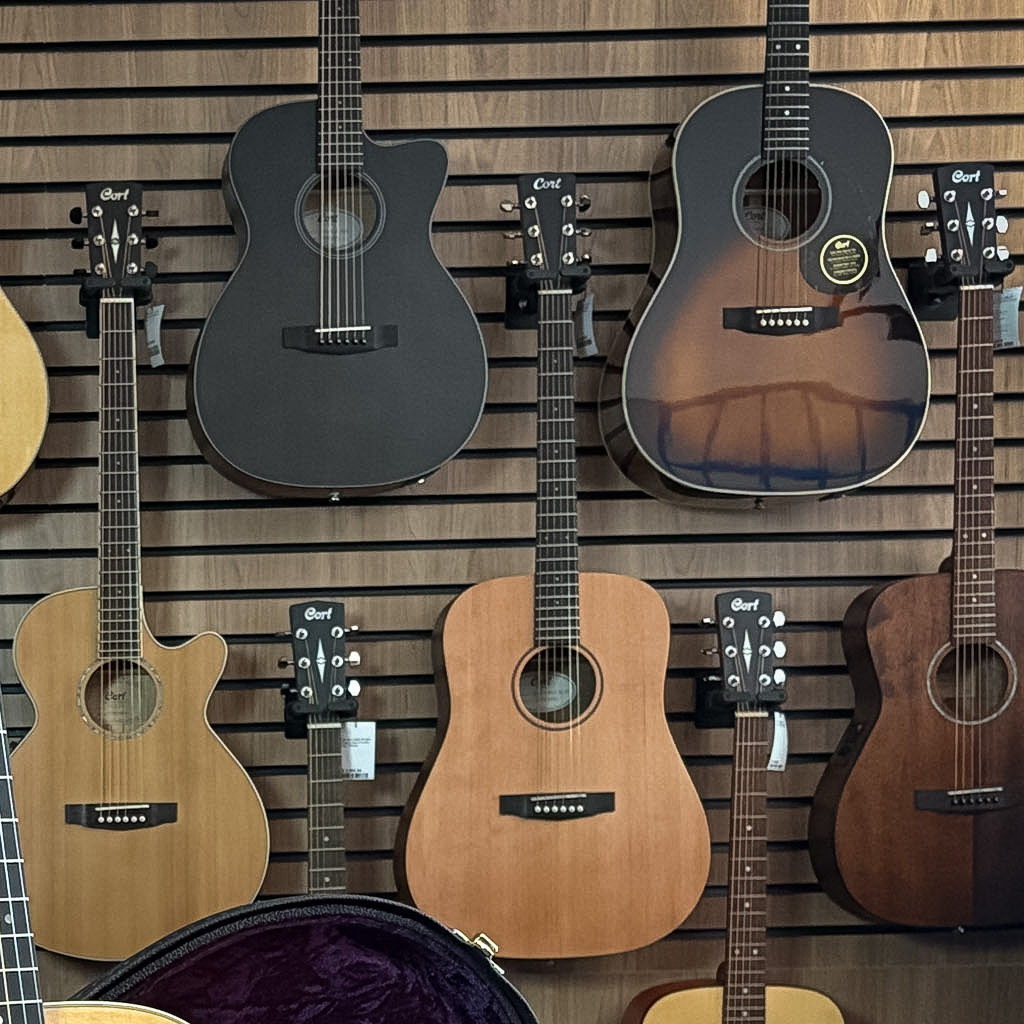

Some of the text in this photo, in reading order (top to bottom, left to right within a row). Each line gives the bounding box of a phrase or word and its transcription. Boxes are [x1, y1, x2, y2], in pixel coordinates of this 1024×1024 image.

[952, 170, 980, 183] Cort
[534, 178, 561, 190] Cort
[100, 188, 130, 201] Cort
[731, 598, 759, 612] Cort
[304, 608, 332, 621] Cort
